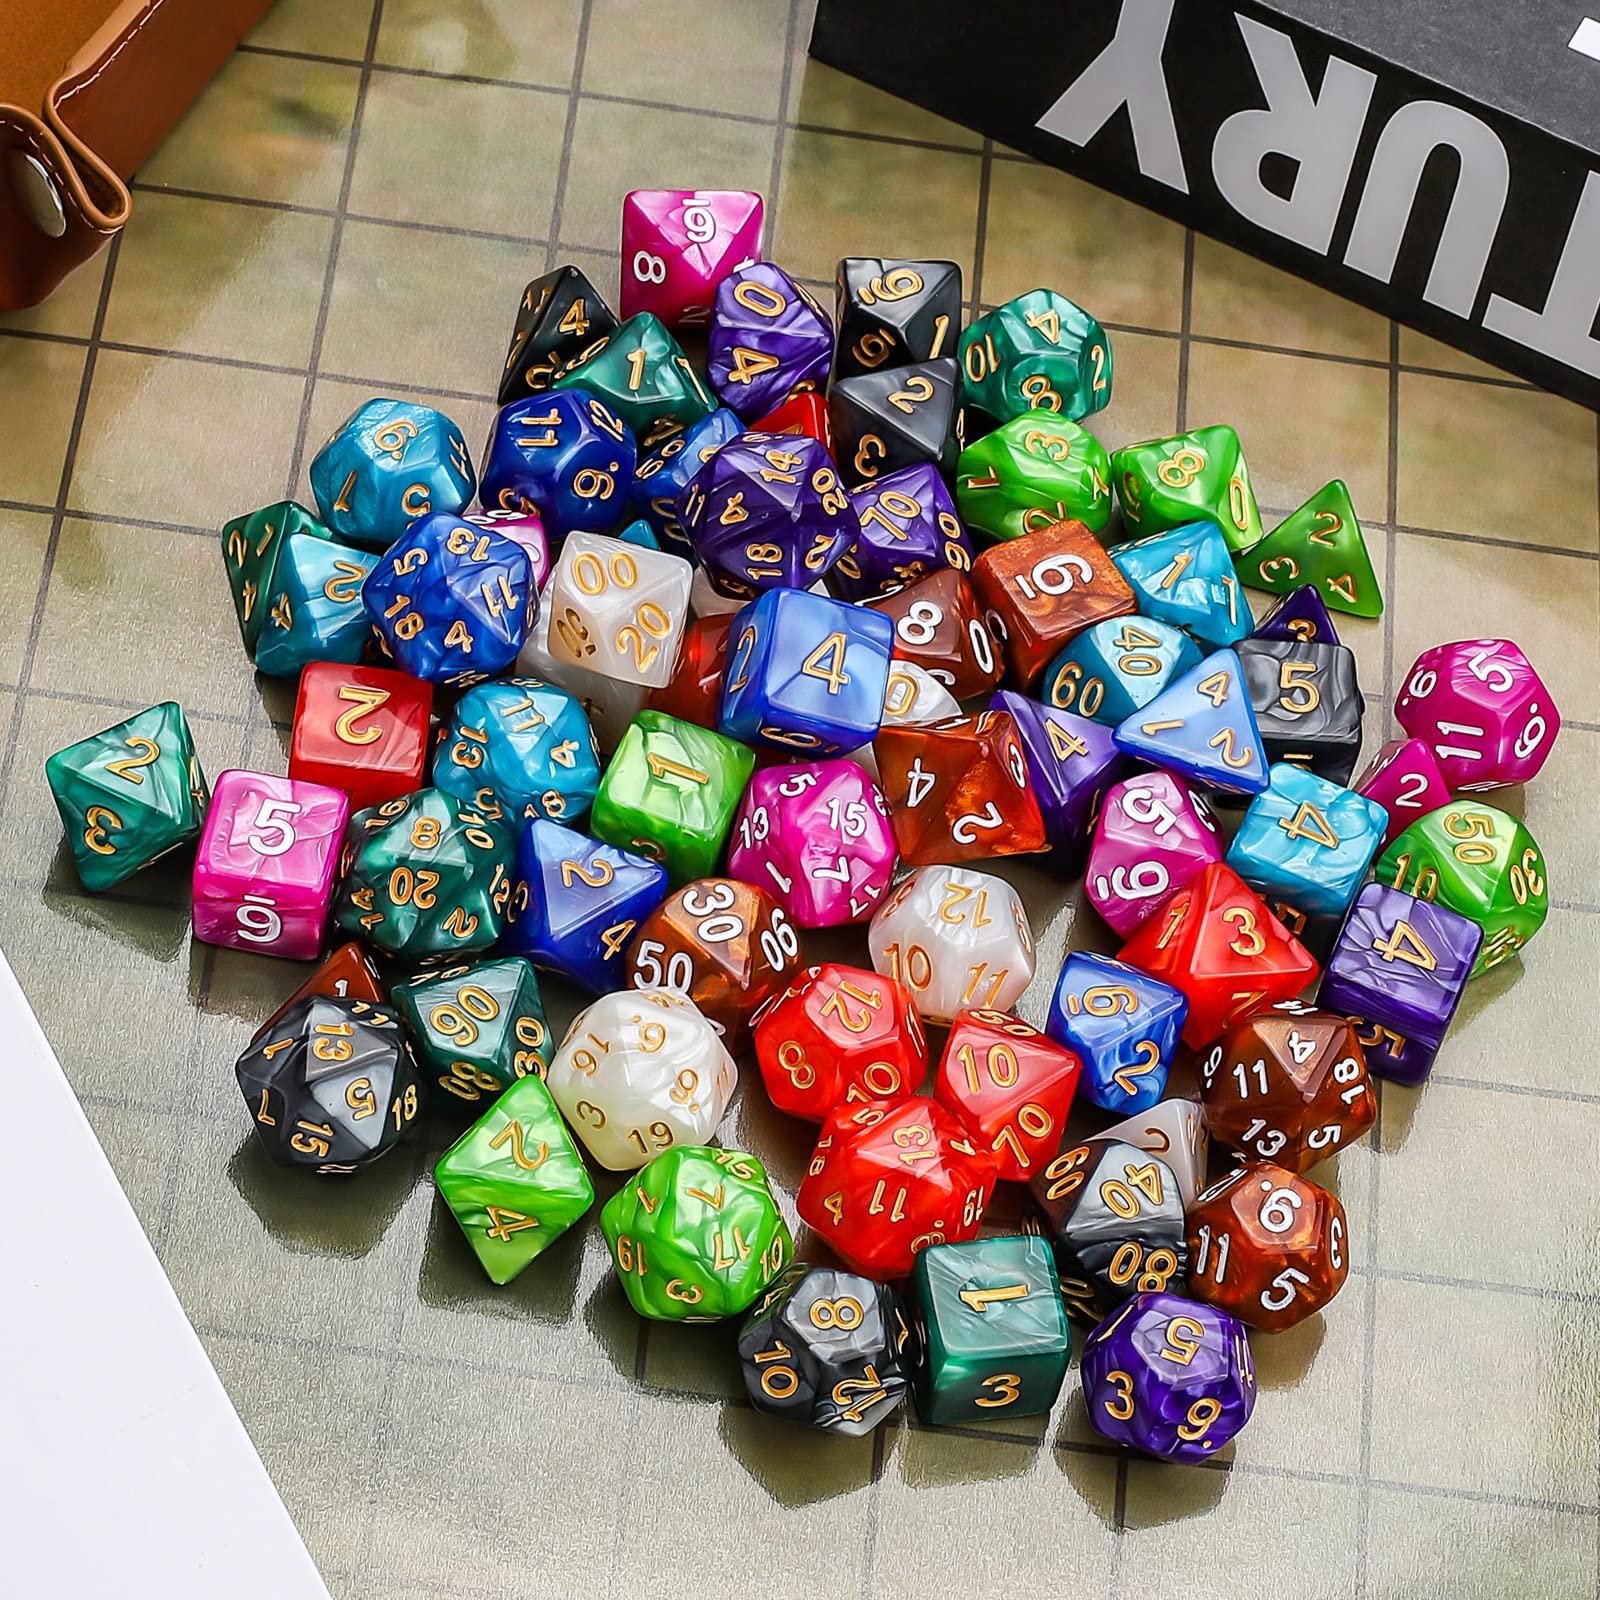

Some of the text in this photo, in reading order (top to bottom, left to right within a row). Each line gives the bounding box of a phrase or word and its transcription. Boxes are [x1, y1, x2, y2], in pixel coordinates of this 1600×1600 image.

[633, 251, 667, 285] 8
[560, 299, 590, 337] 4
[734, 282, 787, 318] 0
[1026, 309, 1061, 345] 4
[628, 349, 647, 391] 1
[729, 347, 780, 385] 4
[966, 333, 1002, 383] 10
[889, 377, 935, 415] 2
[1022, 376, 1063, 414] 8
[517, 409, 563, 448] 11
[589, 400, 626, 442] 12
[761, 450, 802, 483] 14
[855, 434, 887, 478] 3
[1025, 431, 1070, 462] 3
[1157, 448, 1205, 489] 8
[334, 470, 358, 513] 1
[402, 484, 431, 517] 5
[812, 468, 848, 516] 20
[1229, 478, 1249, 531] 0
[861, 491, 922, 541] 70
[1309, 511, 1343, 548] 2
[393, 548, 429, 576] 5
[447, 528, 492, 563] 13
[746, 543, 783, 581] 18
[805, 535, 833, 569] 2
[324, 561, 369, 603] 2
[572, 552, 639, 597] 00
[1162, 554, 1193, 590] 1
[1260, 557, 1300, 583] 3
[1327, 573, 1358, 604] 4
[384, 595, 425, 641] 18
[482, 575, 520, 619] 11
[445, 621, 474, 656] 4
[615, 602, 671, 673] 20
[898, 601, 945, 646] 8
[729, 627, 757, 694] 2
[802, 632, 851, 696] 4
[970, 618, 994, 675] 0
[1114, 626, 1163, 677] 40
[1052, 661, 1106, 718] 60
[1198, 671, 1231, 708] 4
[1280, 662, 1321, 714] 5
[1467, 653, 1514, 693] 5
[335, 687, 392, 746] 2
[1141, 719, 1185, 737] 1
[105, 737, 160, 785] 2
[452, 726, 490, 770] 13
[550, 741, 581, 769] 4
[1045, 718, 1091, 762] 4
[1208, 728, 1253, 768] 2
[1435, 721, 1485, 760] 11
[645, 752, 711, 785] 1
[779, 772, 818, 798] 5
[907, 758, 937, 808] 4
[476, 788, 504, 821] 5
[1395, 774, 1429, 808] 2
[85, 806, 123, 857] 3
[248, 798, 303, 857] 5
[411, 816, 442, 850] 8
[458, 813, 496, 850] 10
[740, 806, 770, 850] 13
[827, 798, 868, 838] 15
[952, 801, 1004, 845] 2
[1123, 789, 1178, 836] 5
[1278, 801, 1341, 850] 4
[1444, 814, 1496, 864] 50
[389, 867, 440, 910] 20
[561, 860, 615, 889] 2
[765, 861, 793, 895] 1
[812, 856, 850, 884] 7
[1509, 848, 1545, 906] 30
[351, 888, 385, 931] 14
[442, 907, 479, 939] 2
[682, 883, 745, 944] 30
[939, 882, 993, 929] 12
[1157, 902, 1191, 951] 1
[601, 919, 638, 961] 4
[1223, 907, 1266, 958] 3
[1372, 920, 1438, 973] 4
[634, 940, 694, 994] 50
[882, 943, 934, 992] 10
[429, 985, 501, 1048] 90
[820, 980, 884, 1034] 12
[262, 1038, 295, 1061] 1
[315, 1022, 356, 1062] 13
[1288, 1031, 1318, 1065] 4
[778, 1040, 817, 1090] 8
[957, 1043, 1019, 1097] 10
[1112, 1039, 1161, 1097] 2
[1233, 1059, 1269, 1099] 11
[1333, 1057, 1368, 1105] 18
[346, 1078, 378, 1122] 5
[393, 1084, 418, 1132] 18
[575, 1100, 607, 1131] 3
[852, 1107, 887, 1127] 5
[291, 1120, 335, 1159] 15
[488, 1119, 551, 1173] 2
[893, 1125, 938, 1166] 13
[991, 1103, 1054, 1169] 70
[1242, 1119, 1288, 1157] 13
[1308, 1125, 1343, 1150] 5
[715, 1150, 758, 1181] 15
[636, 1186, 660, 1215] 1
[686, 1184, 725, 1211] 7
[824, 1192, 844, 1227] 4
[868, 1179, 906, 1223] 11
[1100, 1163, 1163, 1220] 40
[486, 1205, 541, 1243] 4
[714, 1227, 752, 1272] 17
[759, 1235, 784, 1283] 10
[1198, 1223, 1230, 1284] 11
[666, 1279, 706, 1306] 3
[958, 1283, 1031, 1314] 1
[1260, 1267, 1311, 1312] 5
[809, 1297, 865, 1332] 8
[1160, 1314, 1207, 1367] 5
[753, 1339, 800, 1400] 10
[831, 1363, 889, 1424] 12
[974, 1374, 1023, 1409] 3
[1104, 1370, 1136, 1421] 3
